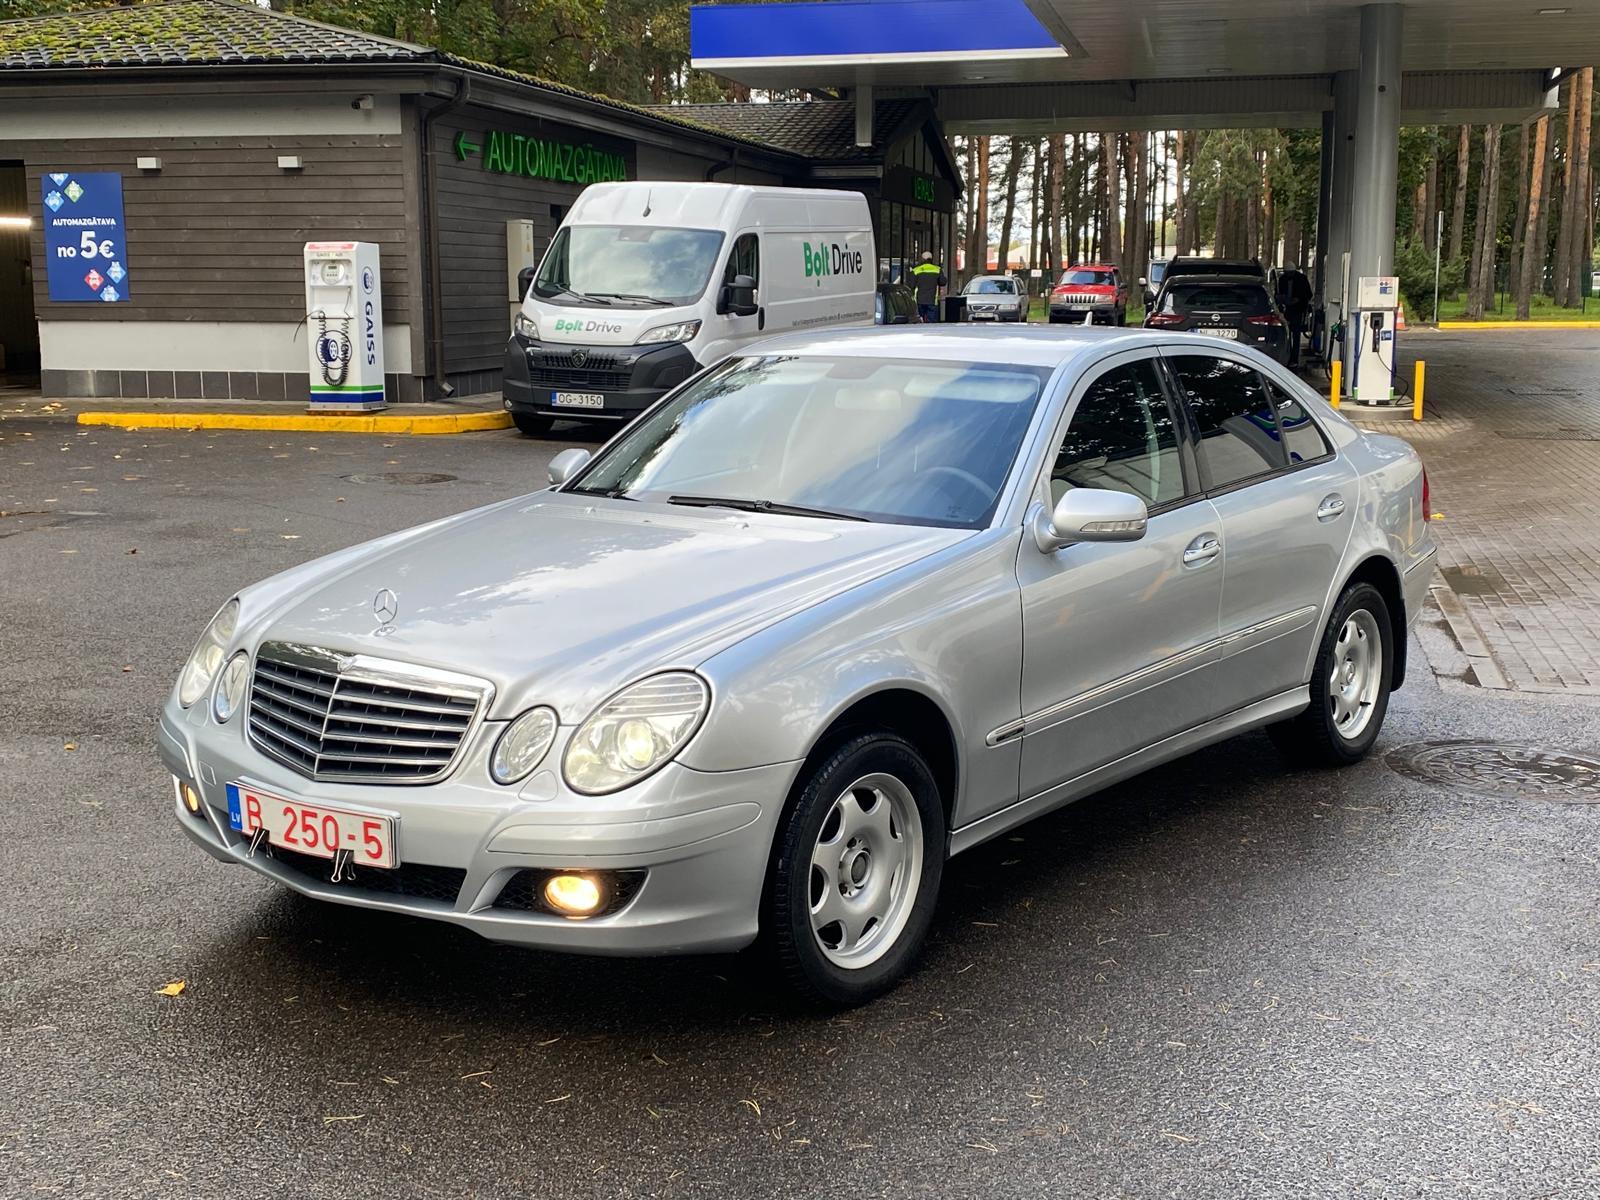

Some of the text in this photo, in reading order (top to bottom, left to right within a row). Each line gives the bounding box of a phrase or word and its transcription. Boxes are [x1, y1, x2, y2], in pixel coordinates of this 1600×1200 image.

[487, 129, 627, 183] AUTOMAZGĀTAVA
[52, 217, 116, 226] AUTOMAZGĀTAVA
[57, 230, 115, 259] no 5€
[803, 241, 863, 287] Bolt Drive
[365, 301, 376, 366] GAISS
[555, 319, 622, 334] Bolt Drive
[558, 393, 603, 406] OG-3150
[231, 812, 241, 824] LV
[246, 794, 384, 860] B 250-5
